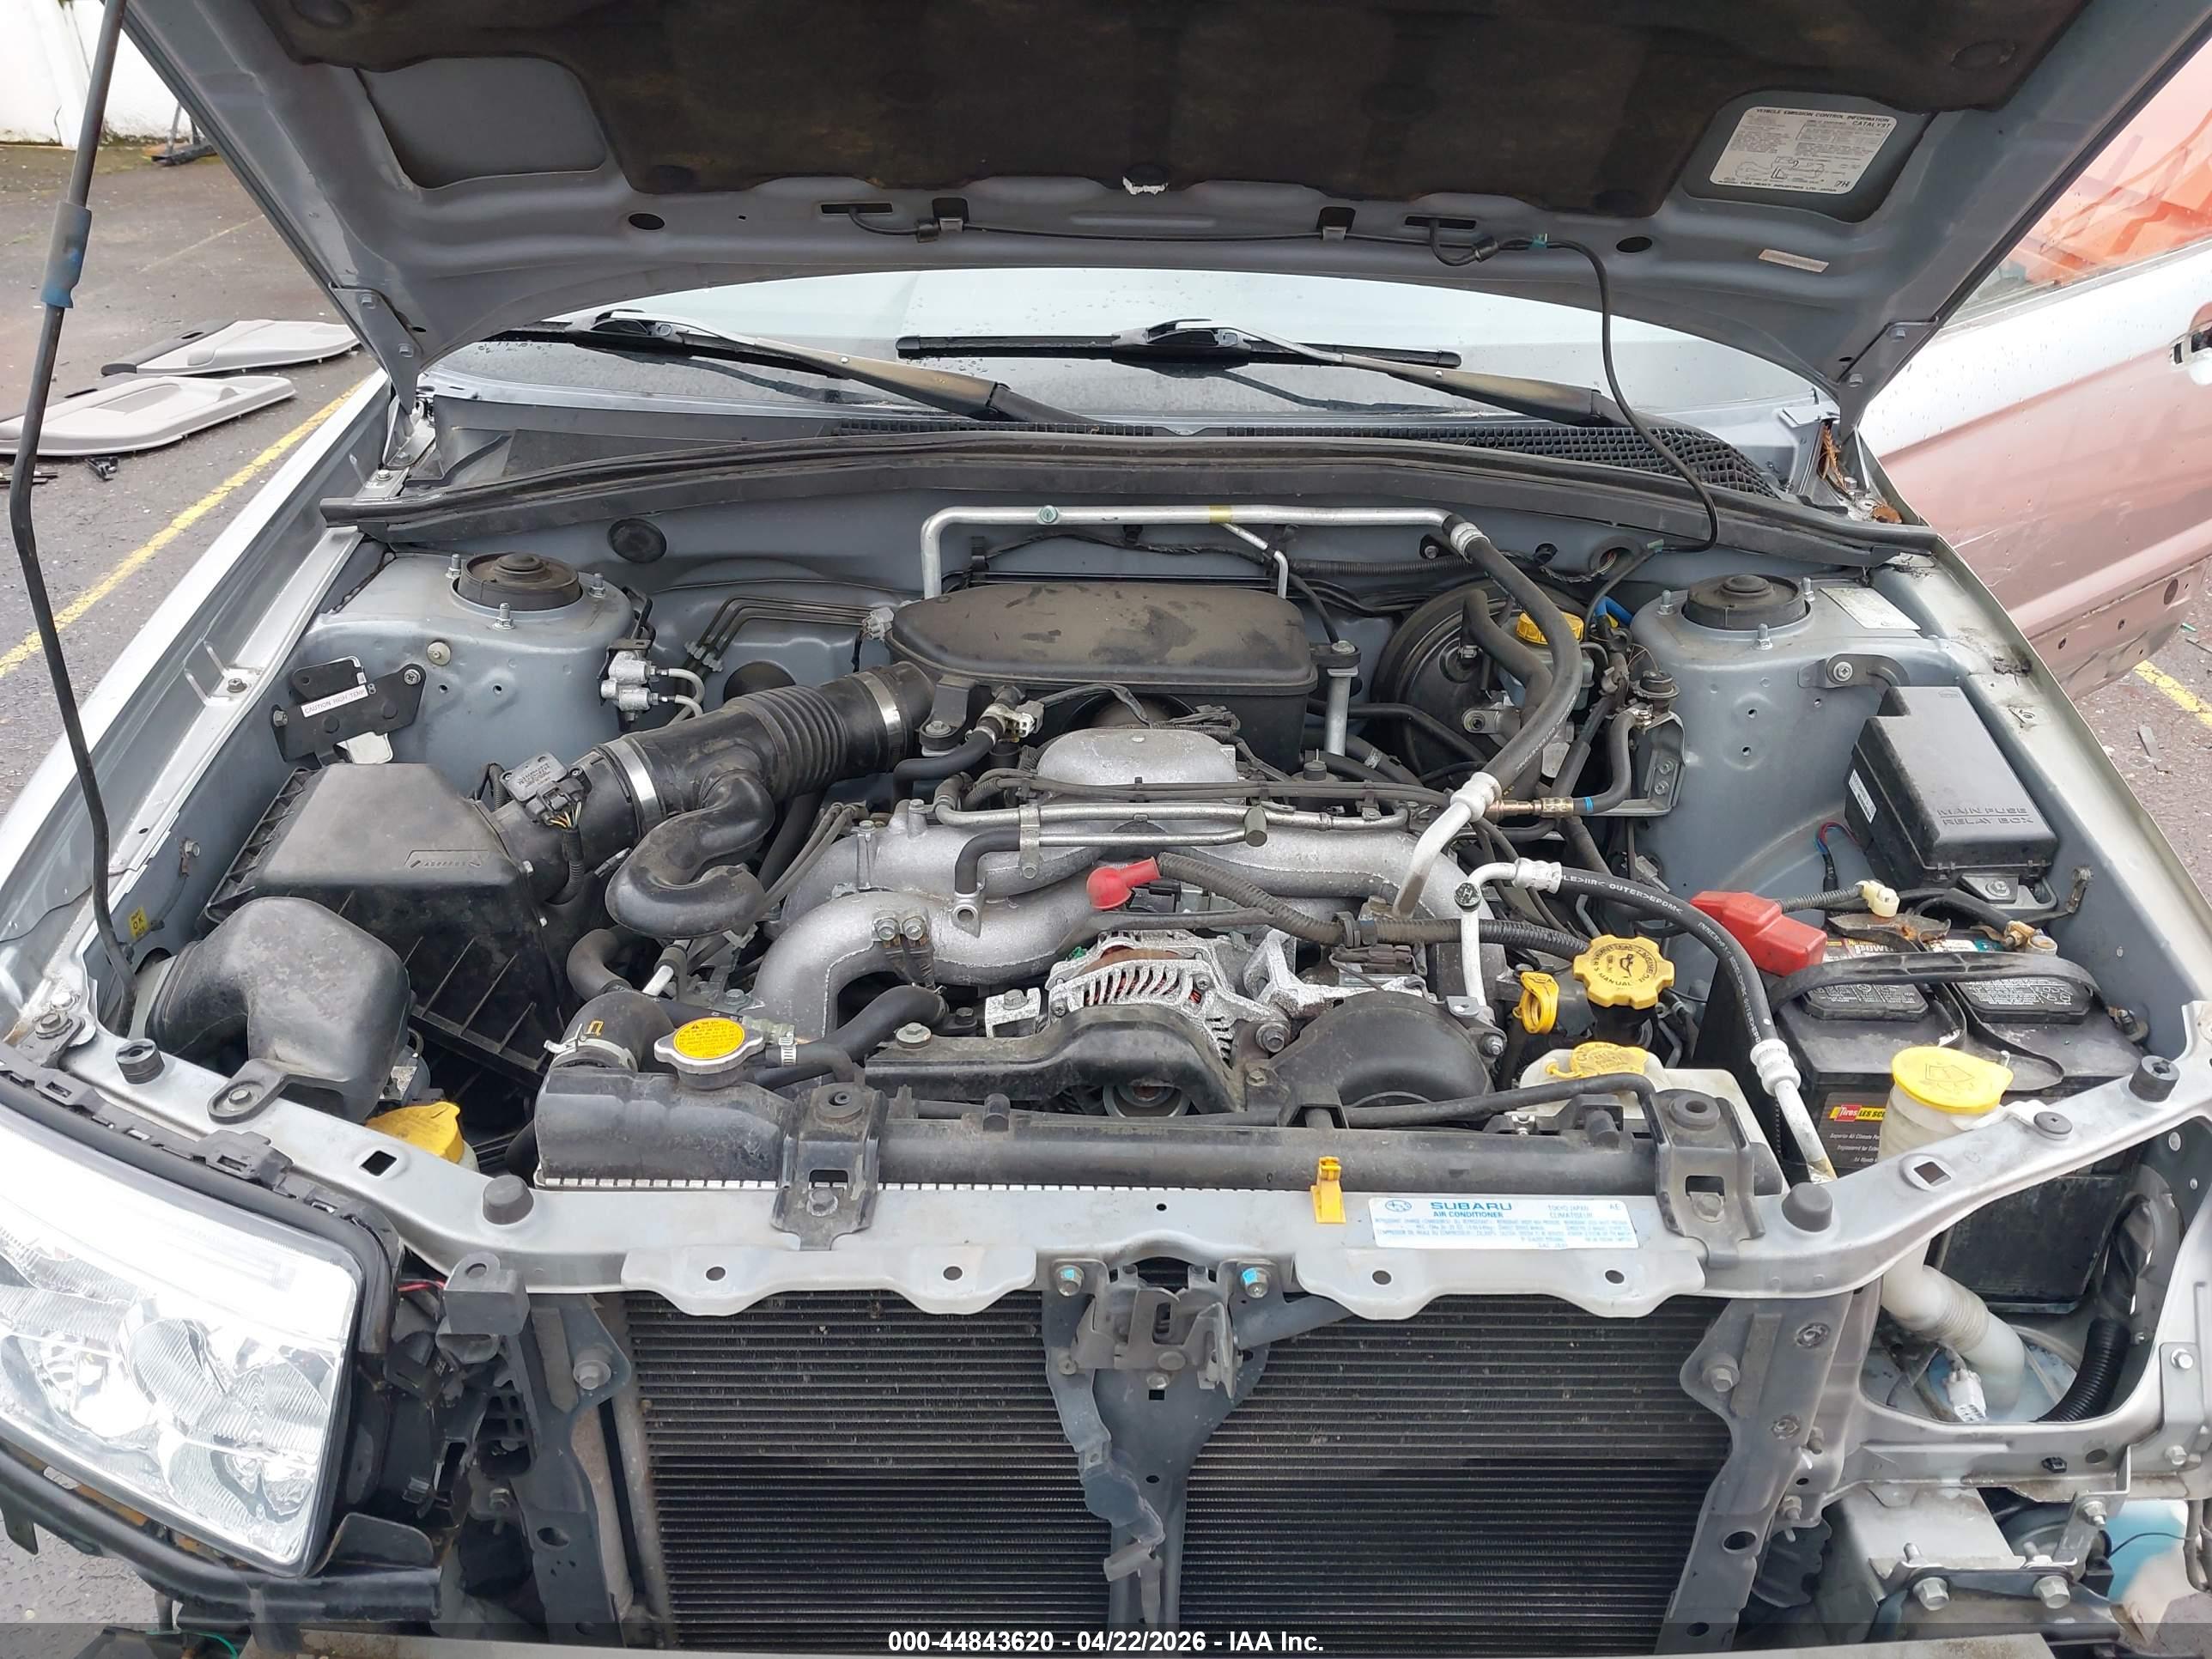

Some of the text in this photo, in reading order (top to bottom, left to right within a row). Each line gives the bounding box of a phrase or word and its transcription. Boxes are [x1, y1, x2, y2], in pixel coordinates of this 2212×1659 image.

[1851, 120, 1892, 129] CATALYST
[304, 689, 365, 714] CAUTION HIGH TEMP
[1937, 807, 1982, 816] MAIN
[1430, 1201, 1513, 1211] SUBARU
